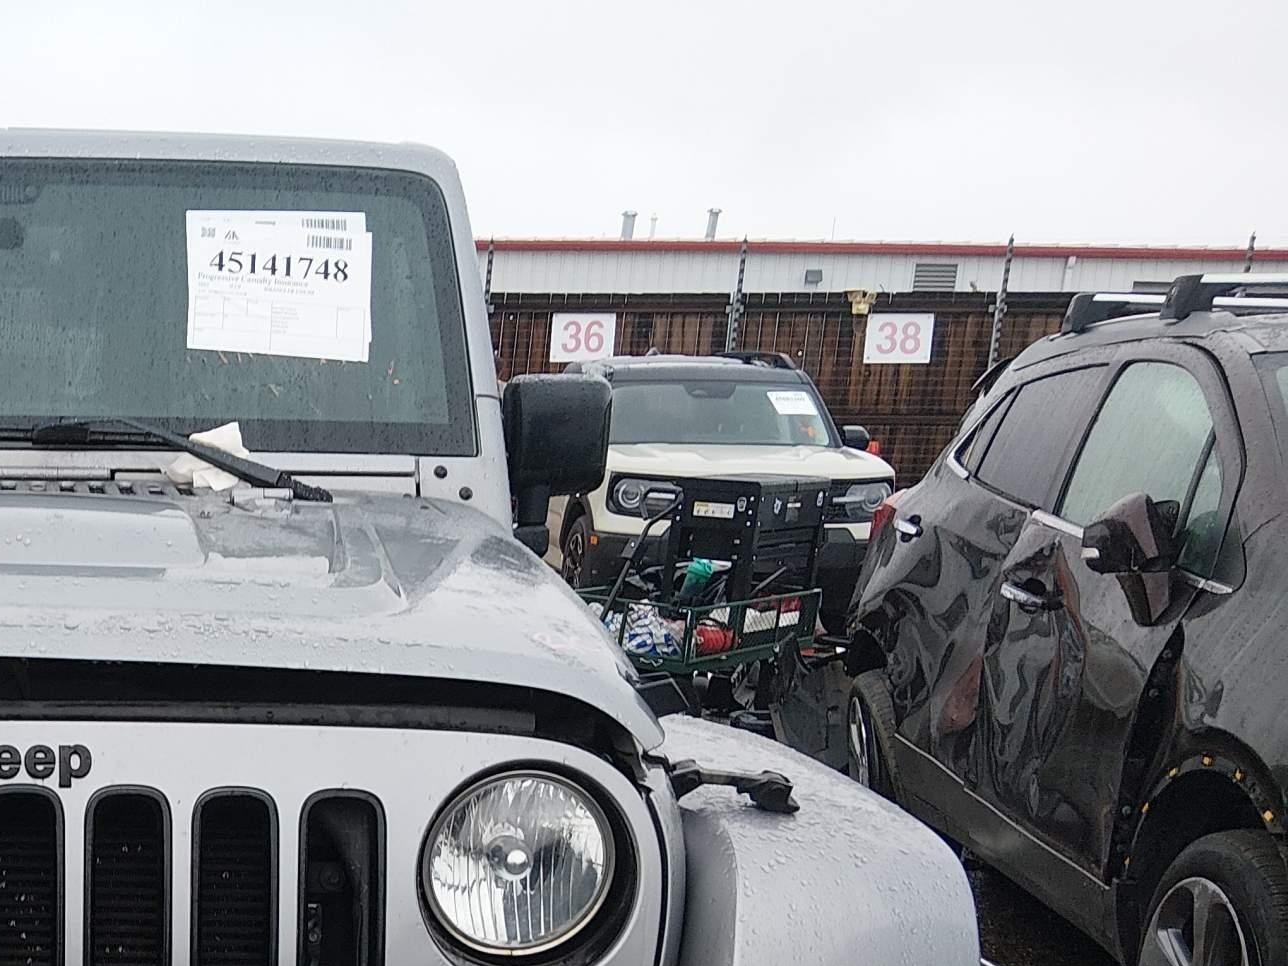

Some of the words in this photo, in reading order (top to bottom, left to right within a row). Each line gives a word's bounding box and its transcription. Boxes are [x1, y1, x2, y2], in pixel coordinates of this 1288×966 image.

[209, 249, 349, 283] 45141748
[562, 320, 605, 353] 36
[876, 321, 922, 355] 38
